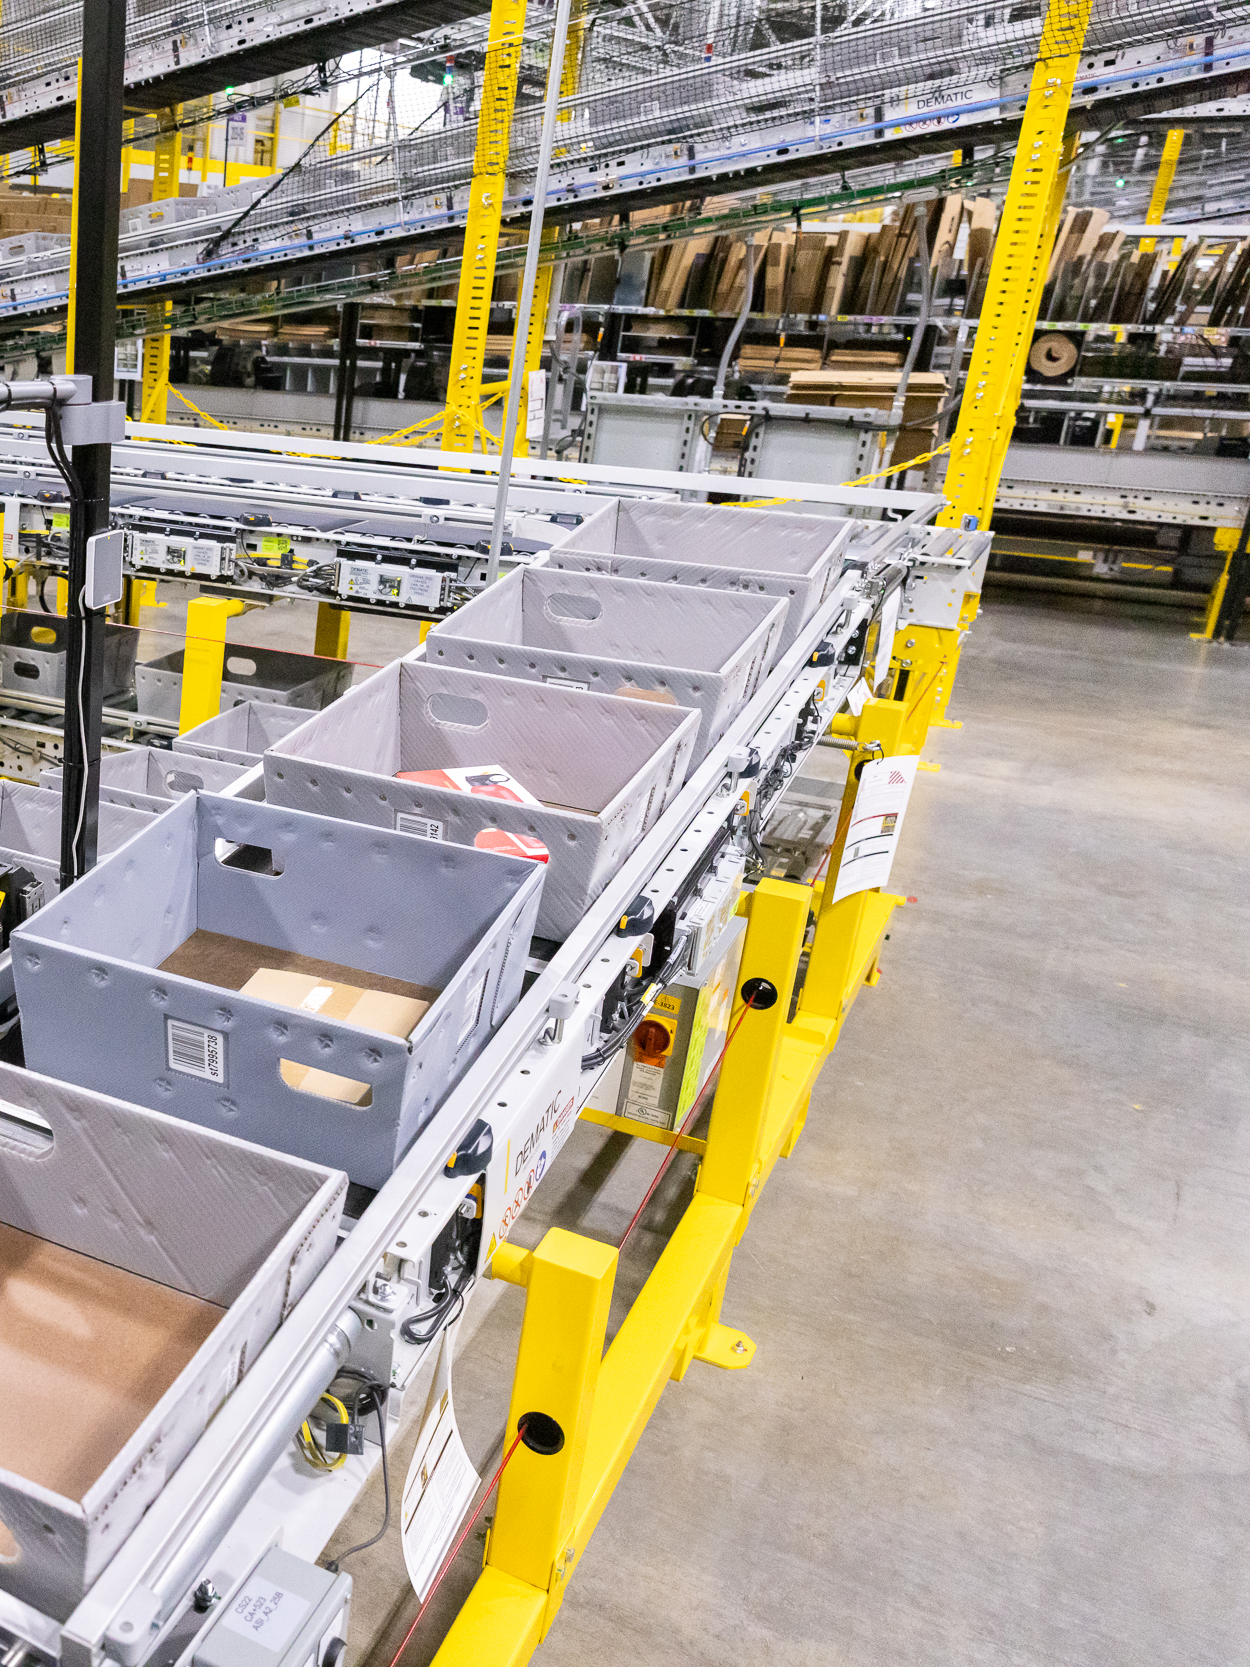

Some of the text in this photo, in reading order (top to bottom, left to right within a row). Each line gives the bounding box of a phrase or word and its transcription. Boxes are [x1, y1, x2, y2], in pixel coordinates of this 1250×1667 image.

[917, 89, 973, 109] DEMATIC
[207, 1034, 219, 1077] st7995738
[514, 1089, 562, 1178] DEMATIC
[235, 1595, 253, 1615] CS22
